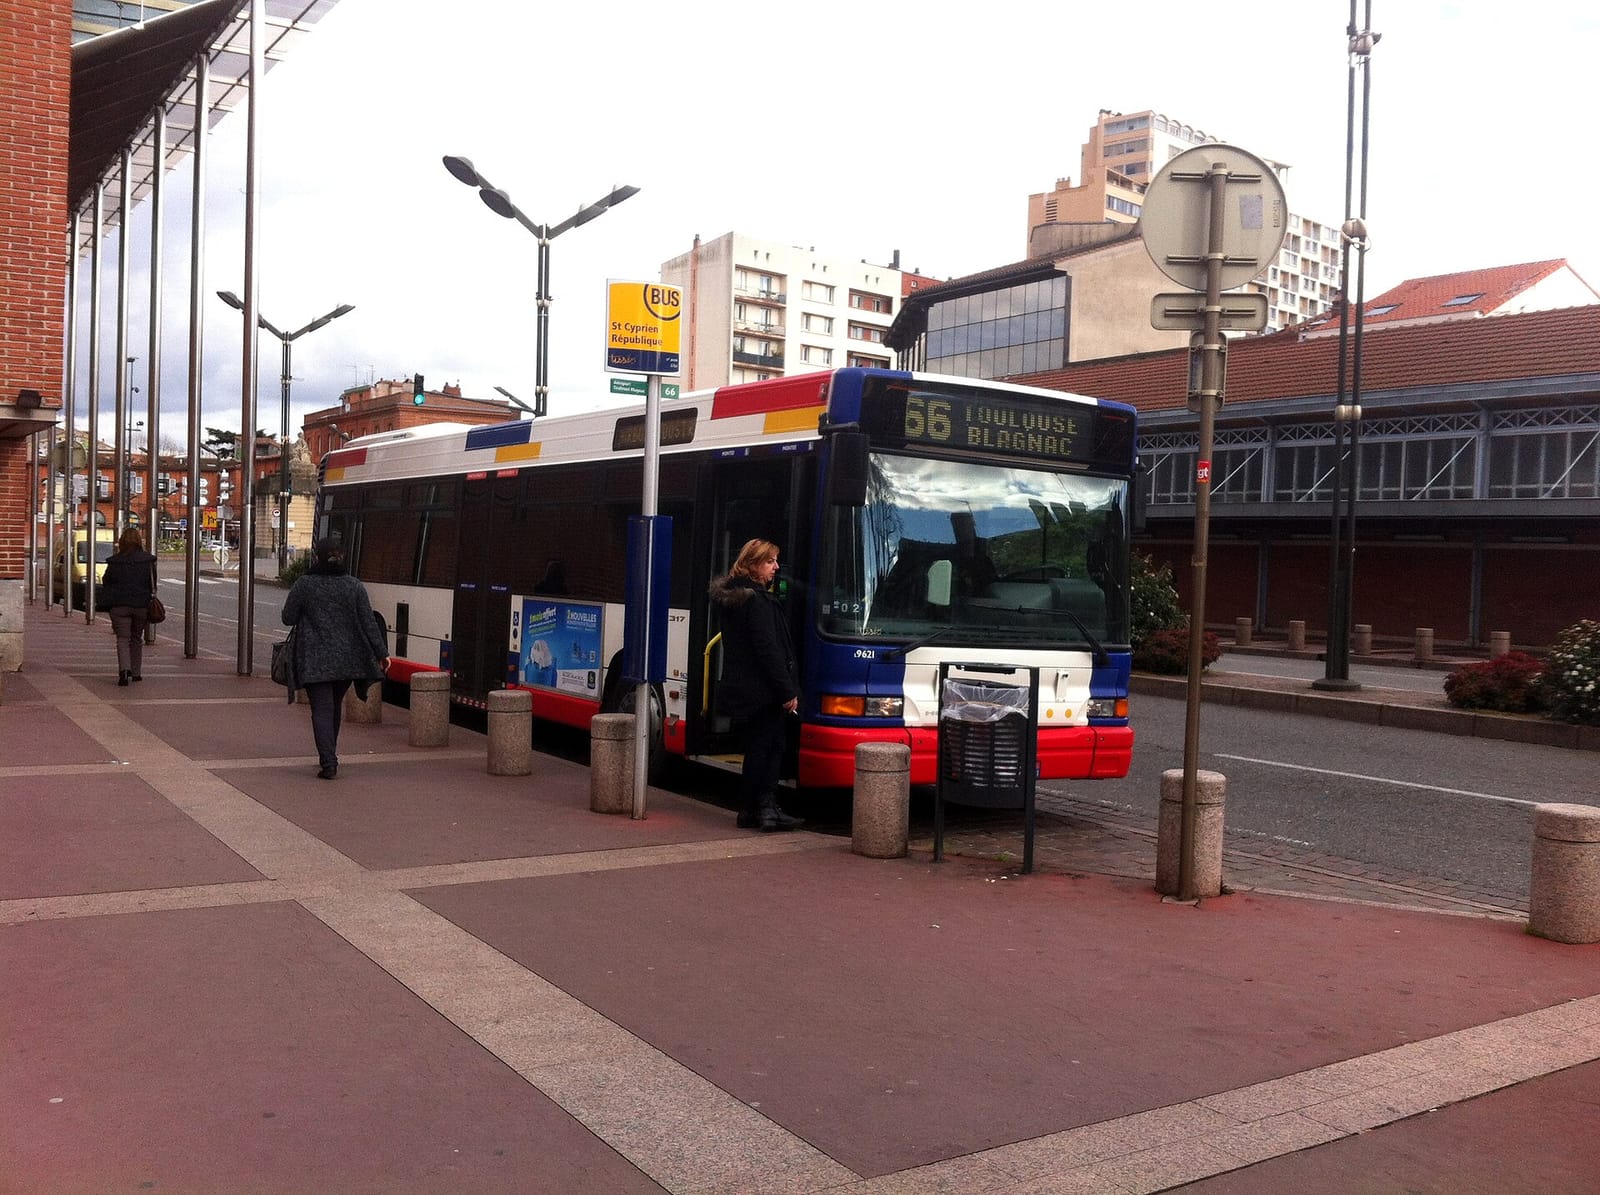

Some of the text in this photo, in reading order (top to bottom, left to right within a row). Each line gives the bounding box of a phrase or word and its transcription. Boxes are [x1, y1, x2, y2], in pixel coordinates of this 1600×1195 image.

[651, 287, 680, 307] BUS
[612, 321, 659, 334] St Cyprien
[611, 333, 663, 347] République
[664, 387, 676, 396] 66
[904, 397, 952, 441] 66
[967, 427, 1073, 455] BLAGNAC
